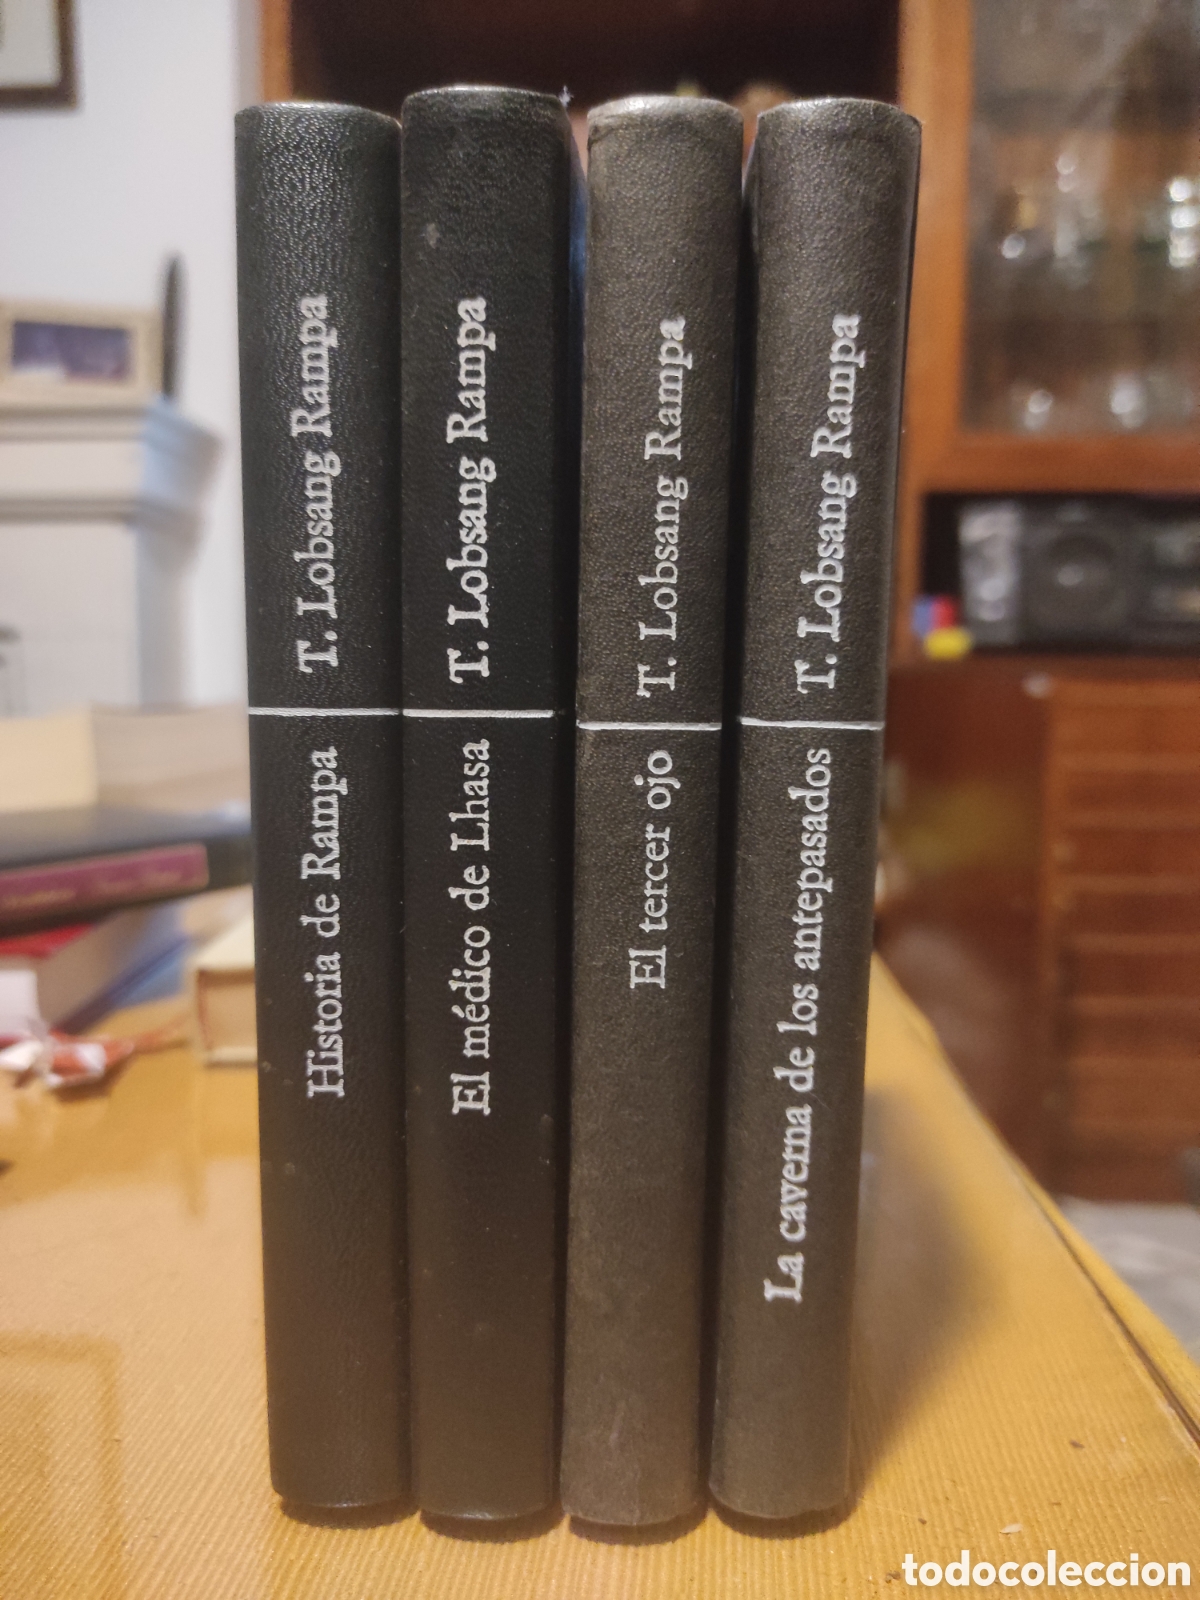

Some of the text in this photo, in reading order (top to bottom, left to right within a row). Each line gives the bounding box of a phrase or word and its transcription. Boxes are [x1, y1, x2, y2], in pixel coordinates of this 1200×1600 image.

[290, 294, 342, 674] T. Lobsang Rampa
[445, 296, 498, 684] T. Lobsang Rampa
[636, 317, 692, 699] T. Lobsang Rampa
[793, 314, 866, 695] T. Lobsang Rampa
[299, 745, 349, 1098] Historia de Rampa
[447, 738, 492, 1116] El médico de Lhasa
[628, 750, 681, 990] El tercer ojo
[763, 748, 834, 1303] La caverna de los antepasados
